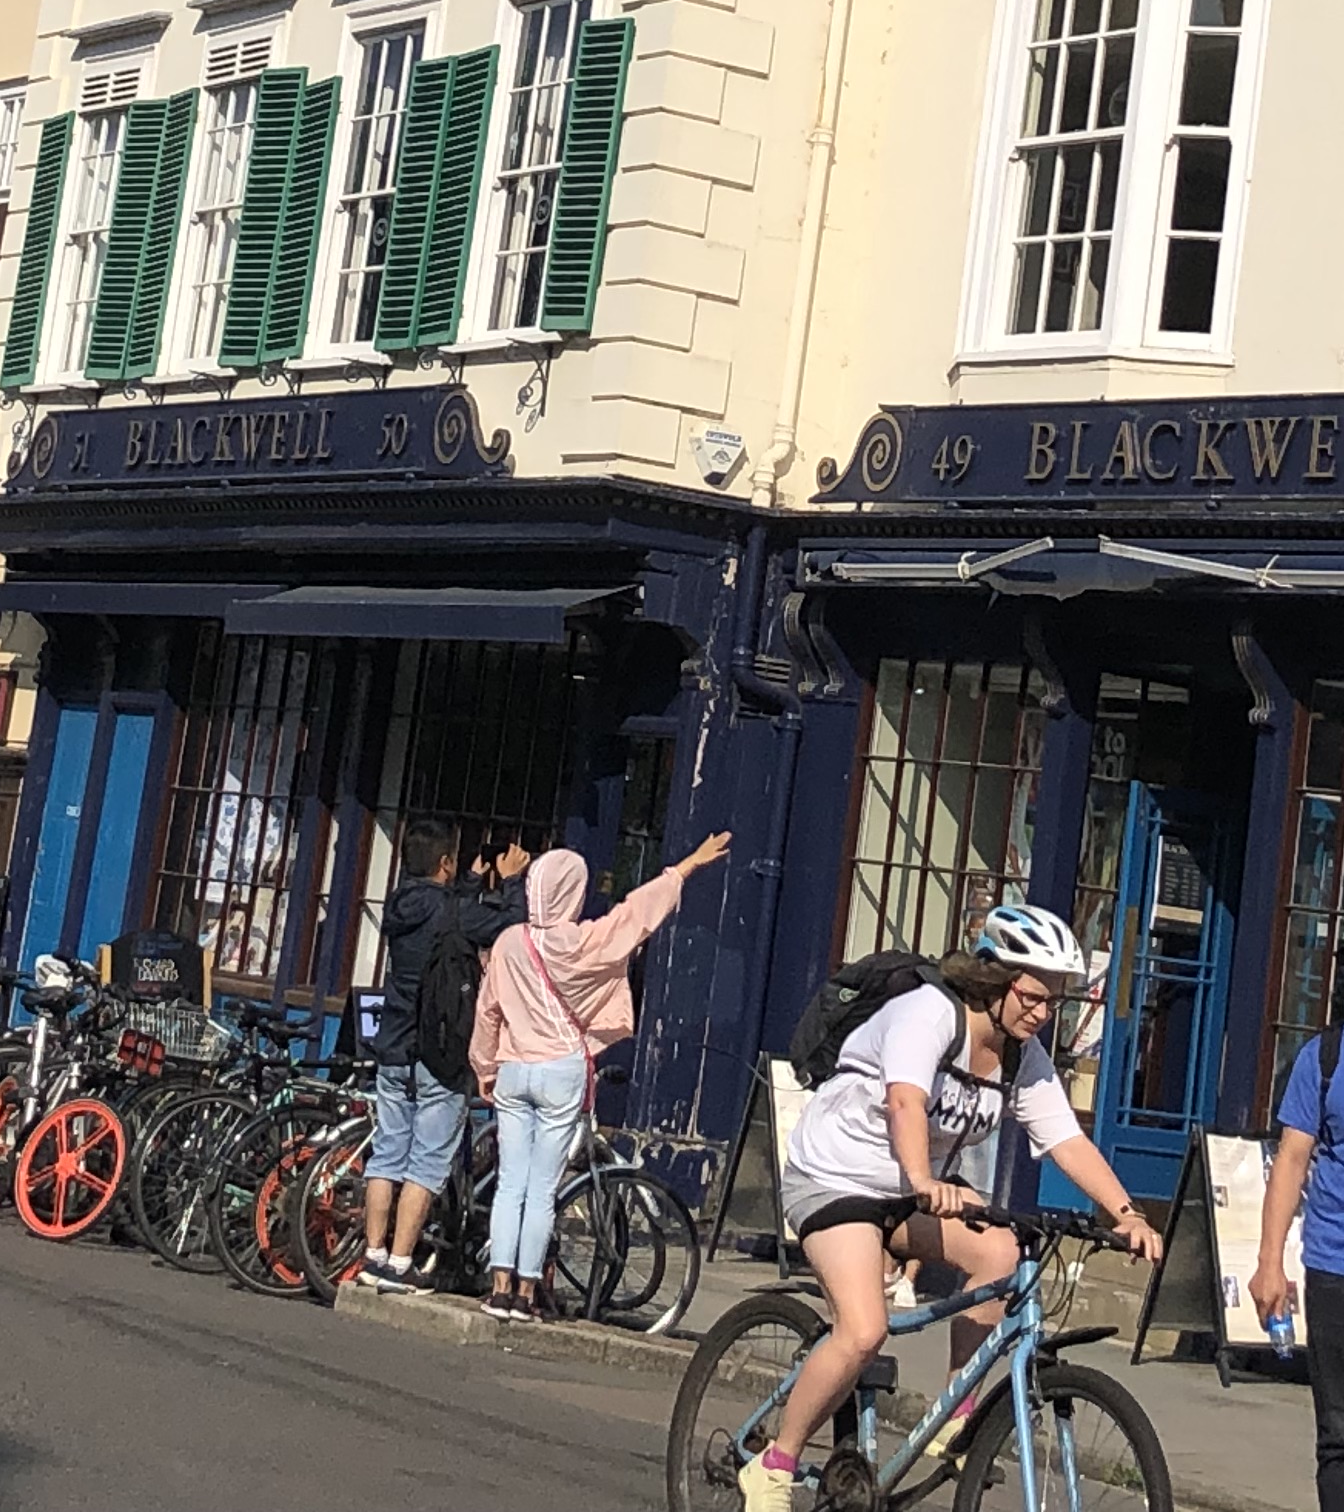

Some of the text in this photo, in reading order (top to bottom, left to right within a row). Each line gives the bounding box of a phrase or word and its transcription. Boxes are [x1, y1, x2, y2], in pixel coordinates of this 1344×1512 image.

[68, 407, 408, 471] 51 BLACKWELL 50
[931, 434, 975, 482] 49
